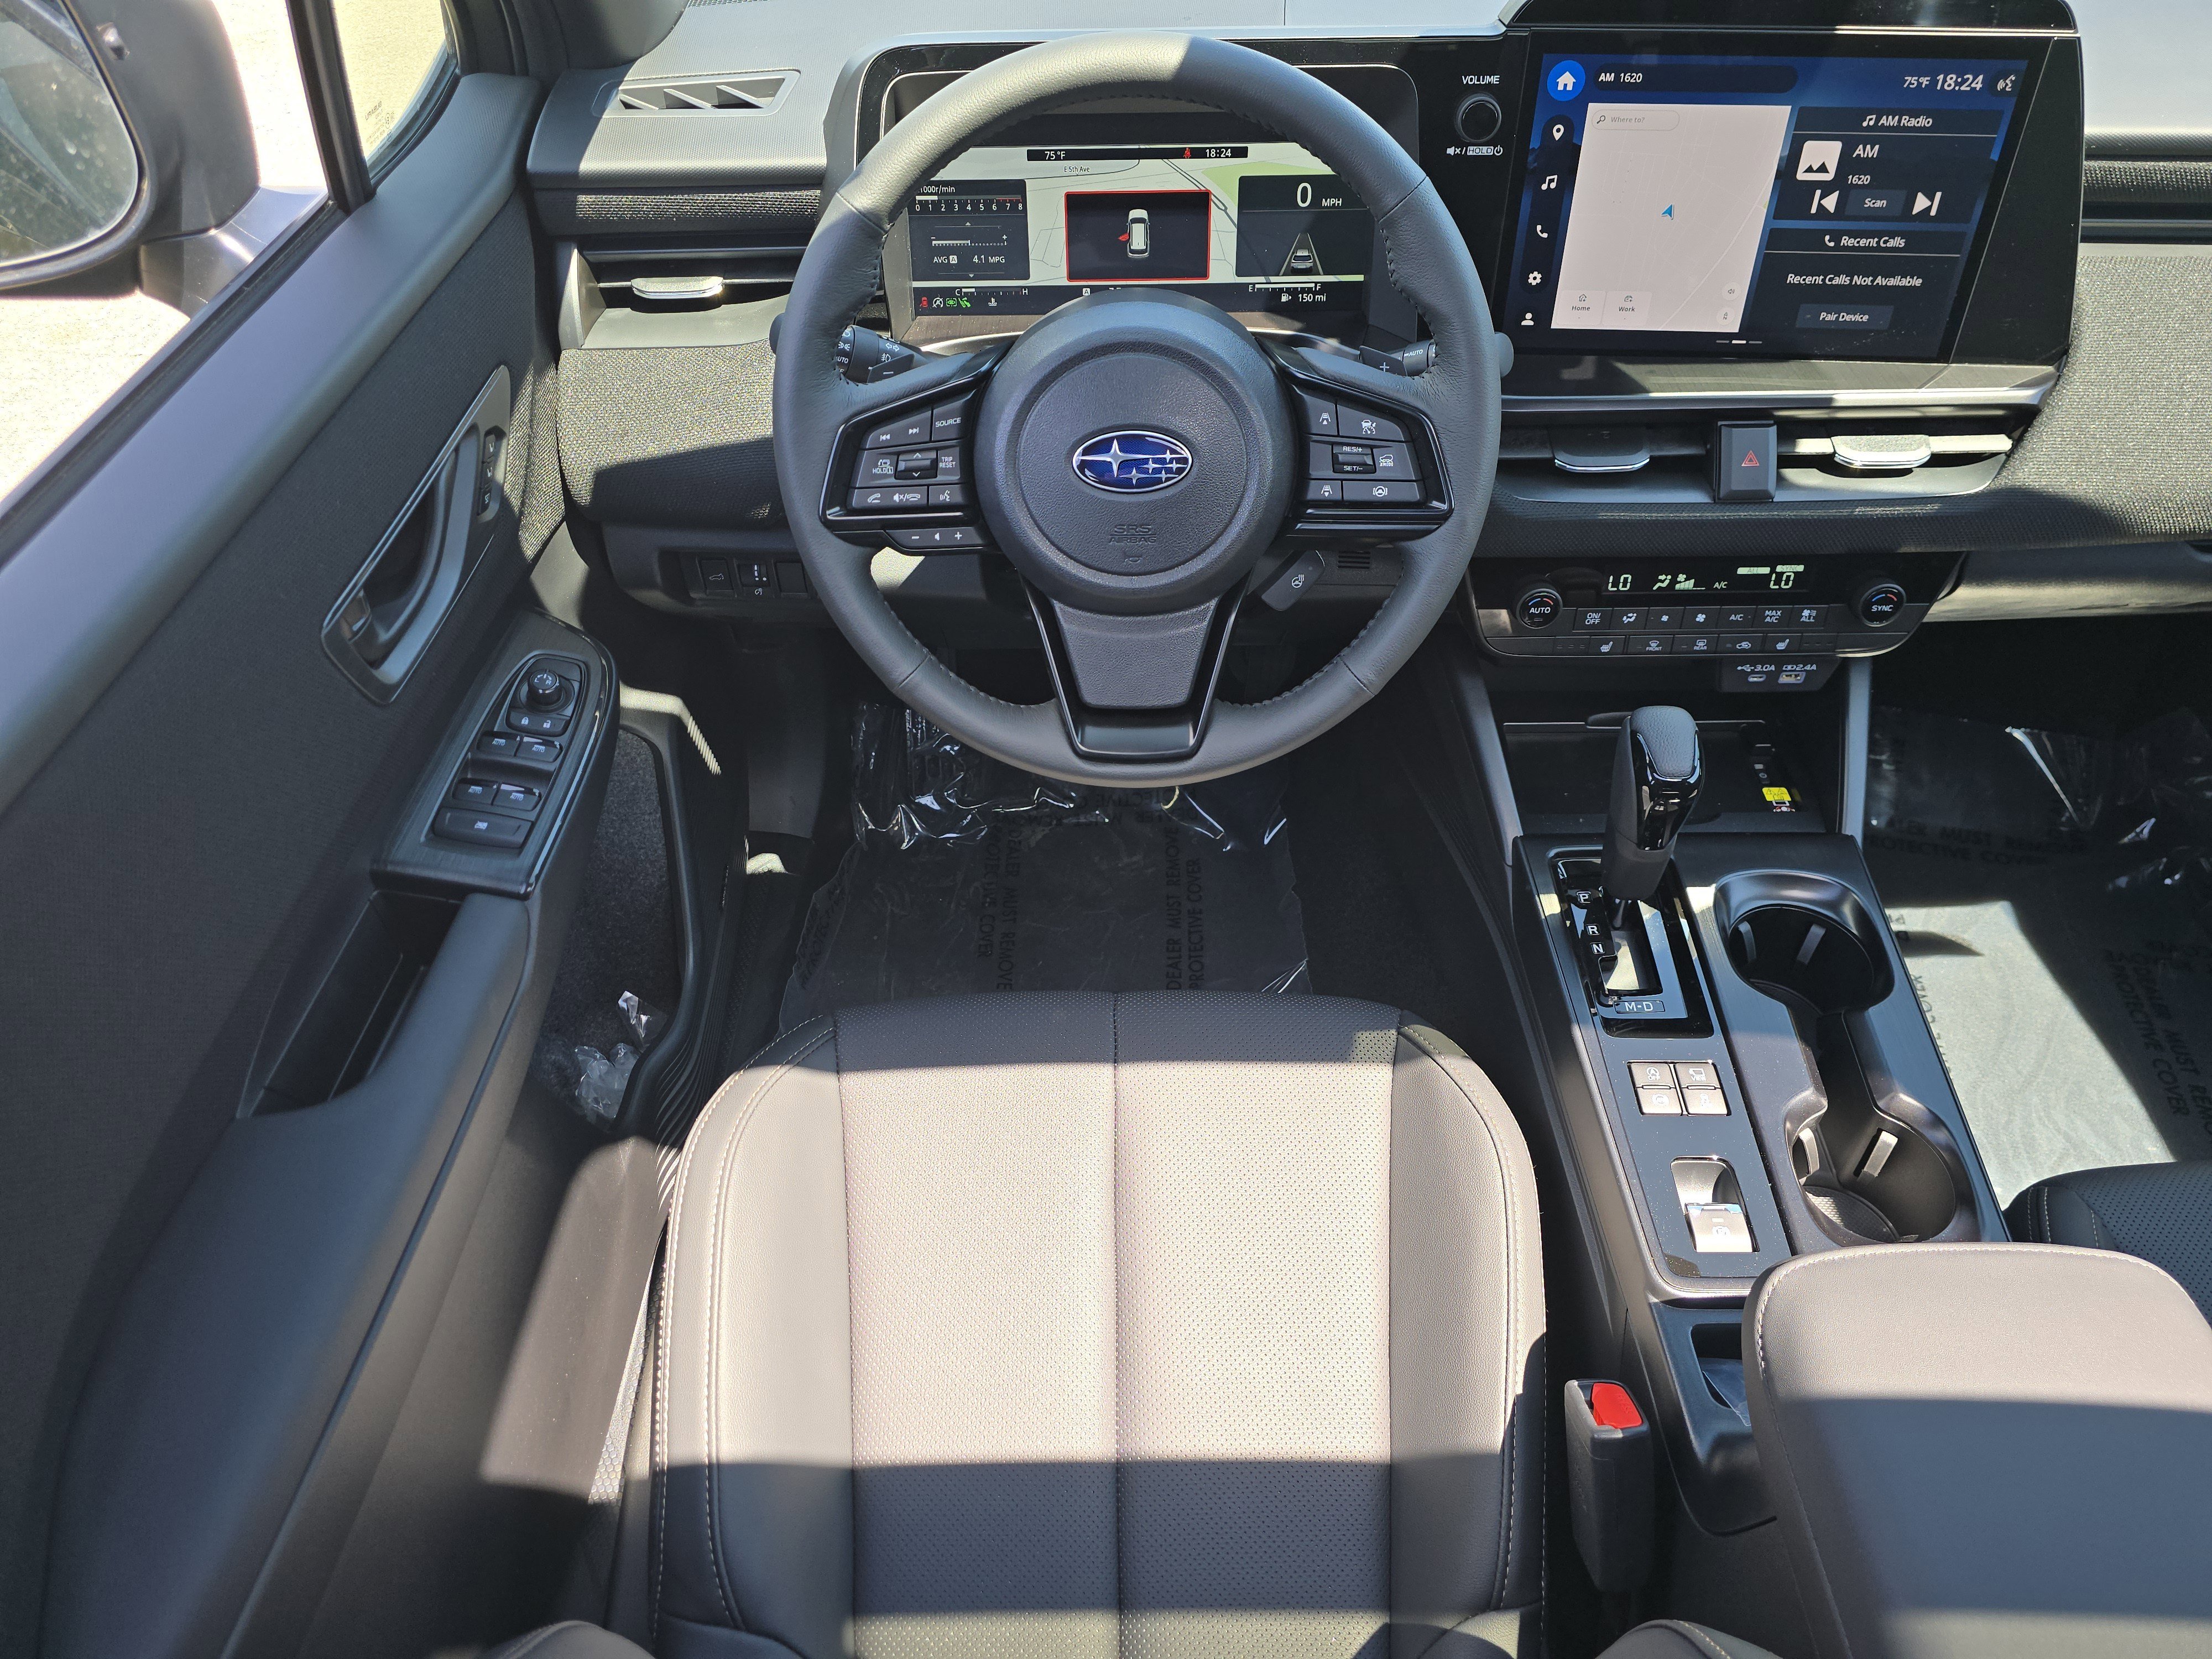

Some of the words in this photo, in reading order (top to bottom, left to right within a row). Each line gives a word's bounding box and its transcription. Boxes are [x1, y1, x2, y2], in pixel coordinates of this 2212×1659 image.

[1462, 75, 1500, 85] VOLUME
[1598, 72, 1615, 82] AM
[1619, 72, 1643, 82] 1620
[1903, 76, 1931, 88] 75°F
[1936, 74, 1984, 91] 18:24
[1878, 115, 1898, 127] AM
[1900, 116, 1933, 128] Radio
[1044, 150, 1066, 160] 75°F
[1206, 148, 1232, 158] 18:24
[1468, 147, 1493, 155] HOLD
[1853, 144, 1879, 158] AM
[1847, 175, 1871, 185] 1620
[1297, 182, 1312, 207] 0
[1322, 198, 1342, 207] MPH
[1864, 198, 1887, 208] Scan
[1840, 236, 1879, 247] Recent
[1880, 236, 1906, 248] Calls
[973, 255, 985, 263] 4.1
[1786, 274, 1823, 285] Recent
[1825, 274, 1850, 285] Calls
[1852, 275, 1873, 285] Not
[1874, 275, 1923, 287] Available
[1298, 293, 1313, 302] 150
[1315, 293, 1327, 302] mi
[1819, 312, 1838, 321] Pair
[1839, 312, 1869, 322] Device
[935, 417, 962, 427] SOURCE
[1164, 827, 1181, 886] REMOVE
[1186, 857, 1202, 902] COVER
[1579, 894, 1589, 902] P
[1002, 888, 1018, 924] MUST
[1166, 894, 1182, 929] MUST
[1587, 925, 1598, 934] R
[978, 914, 995, 958] COVER
[1187, 907, 1205, 989] PROTECTIVE
[1592, 943, 1604, 953] N
[997, 931, 1016, 991] REMOVE
[1166, 938, 1182, 990] DEALER
[1625, 1001, 1653, 1011] M-D
[2152, 1058, 2190, 1116] COVER
